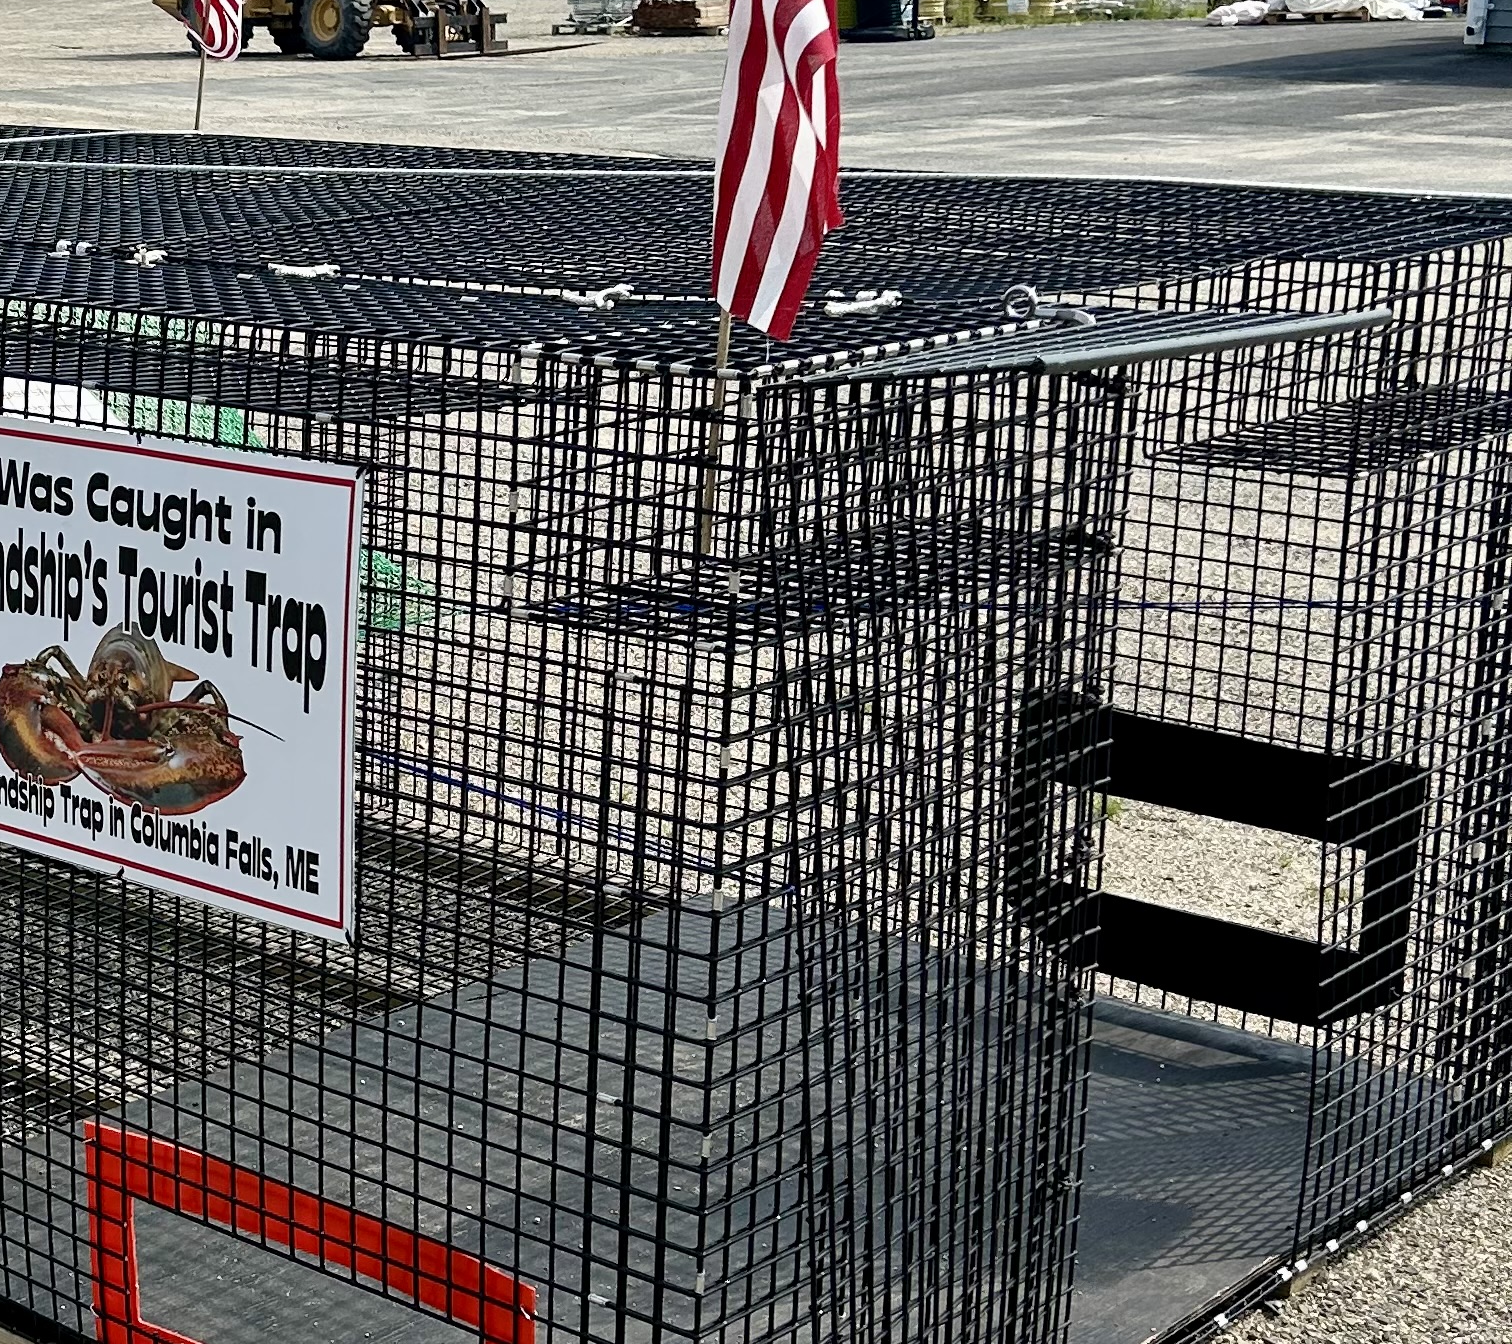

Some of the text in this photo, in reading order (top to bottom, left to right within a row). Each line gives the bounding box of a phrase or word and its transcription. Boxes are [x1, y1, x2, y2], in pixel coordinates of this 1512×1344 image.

[86, 471, 233, 551] Caught
[245, 496, 282, 555] in
[118, 545, 234, 658] Tourist
[245, 569, 328, 714] Trap
[59, 784, 104, 841] Trap
[108, 794, 125, 839] in
[130, 801, 219, 867] Columbia
[225, 828, 279, 890] Falls,
[284, 845, 320, 895] ME
